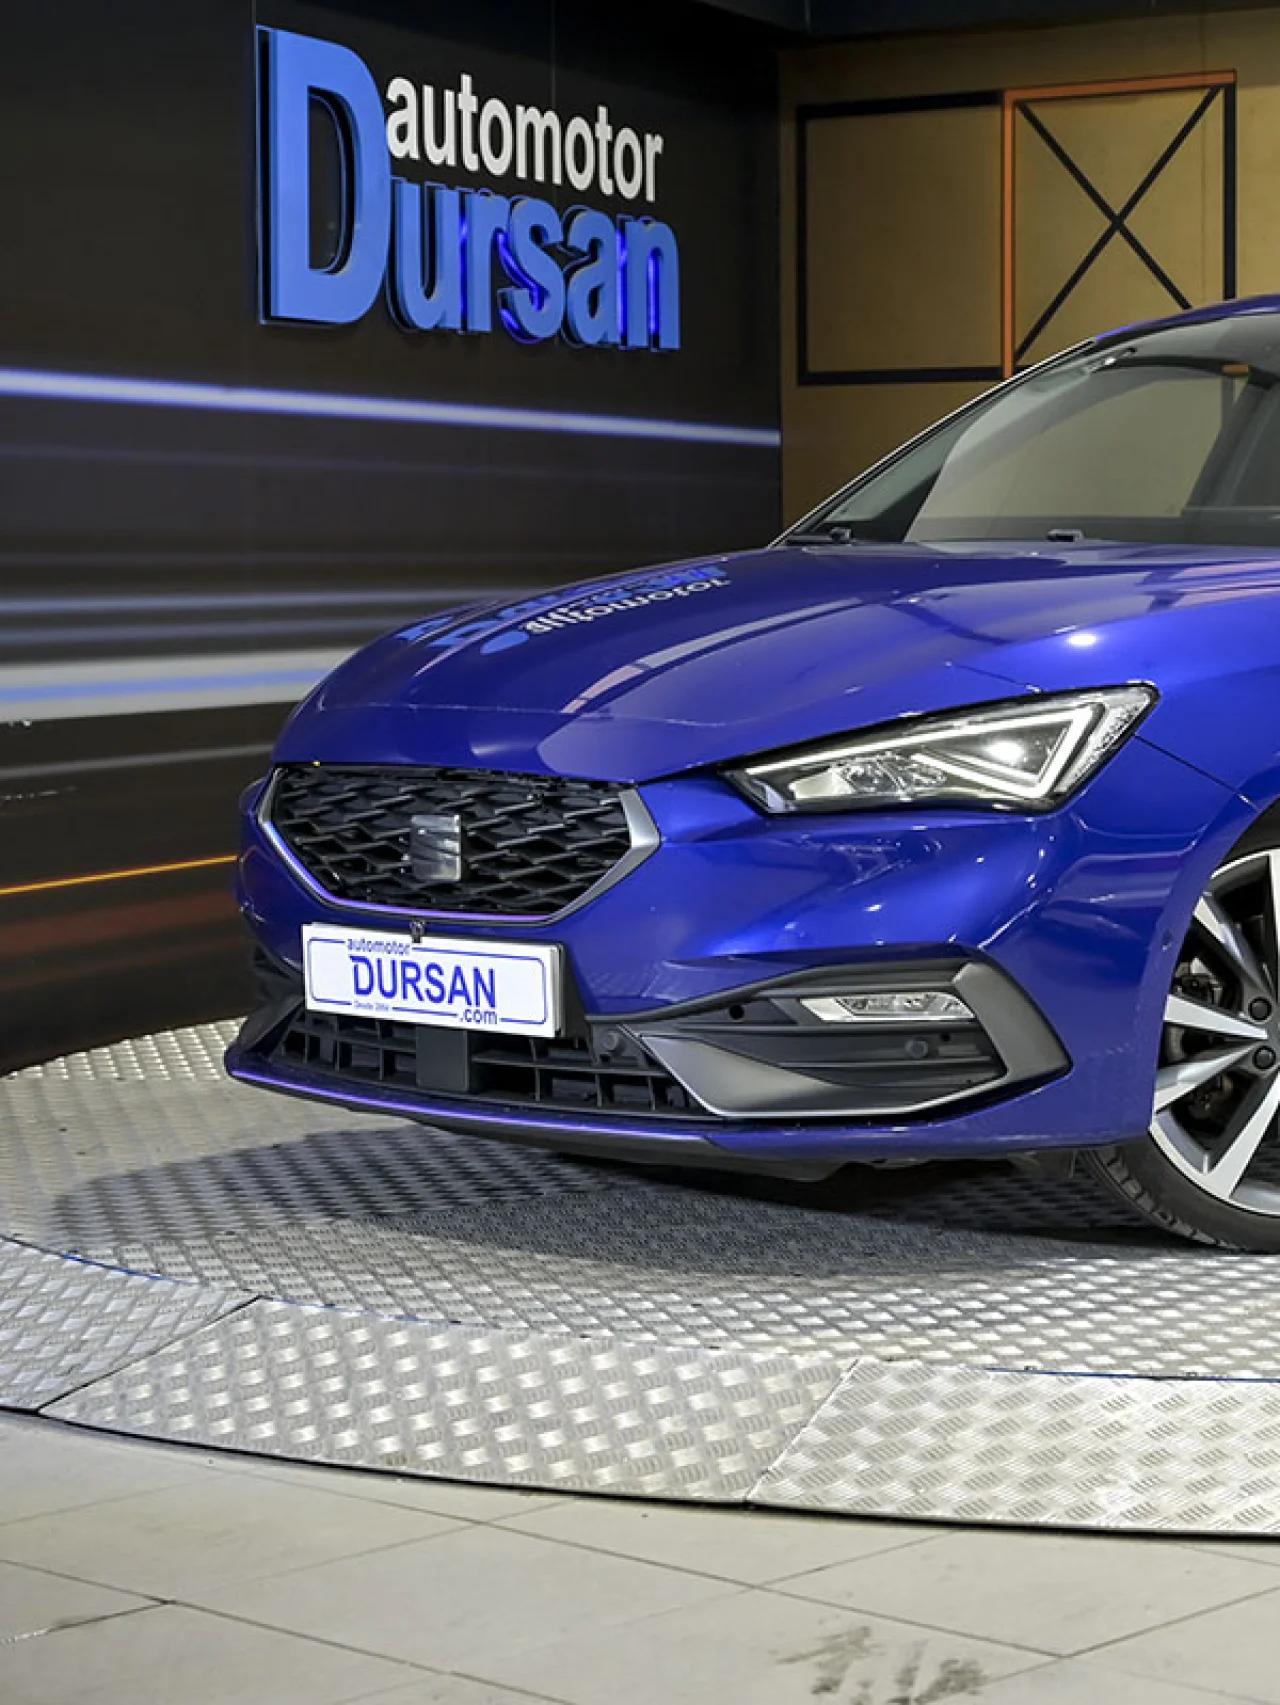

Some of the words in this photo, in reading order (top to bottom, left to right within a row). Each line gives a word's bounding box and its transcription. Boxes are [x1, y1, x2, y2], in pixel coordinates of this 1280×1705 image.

[386, 73, 664, 201] automotor
[257, 26, 680, 350] Dursan
[347, 938, 410, 955] automotor
[350, 955, 496, 1008] DURSAN
[460, 1008, 497, 1025] .com
